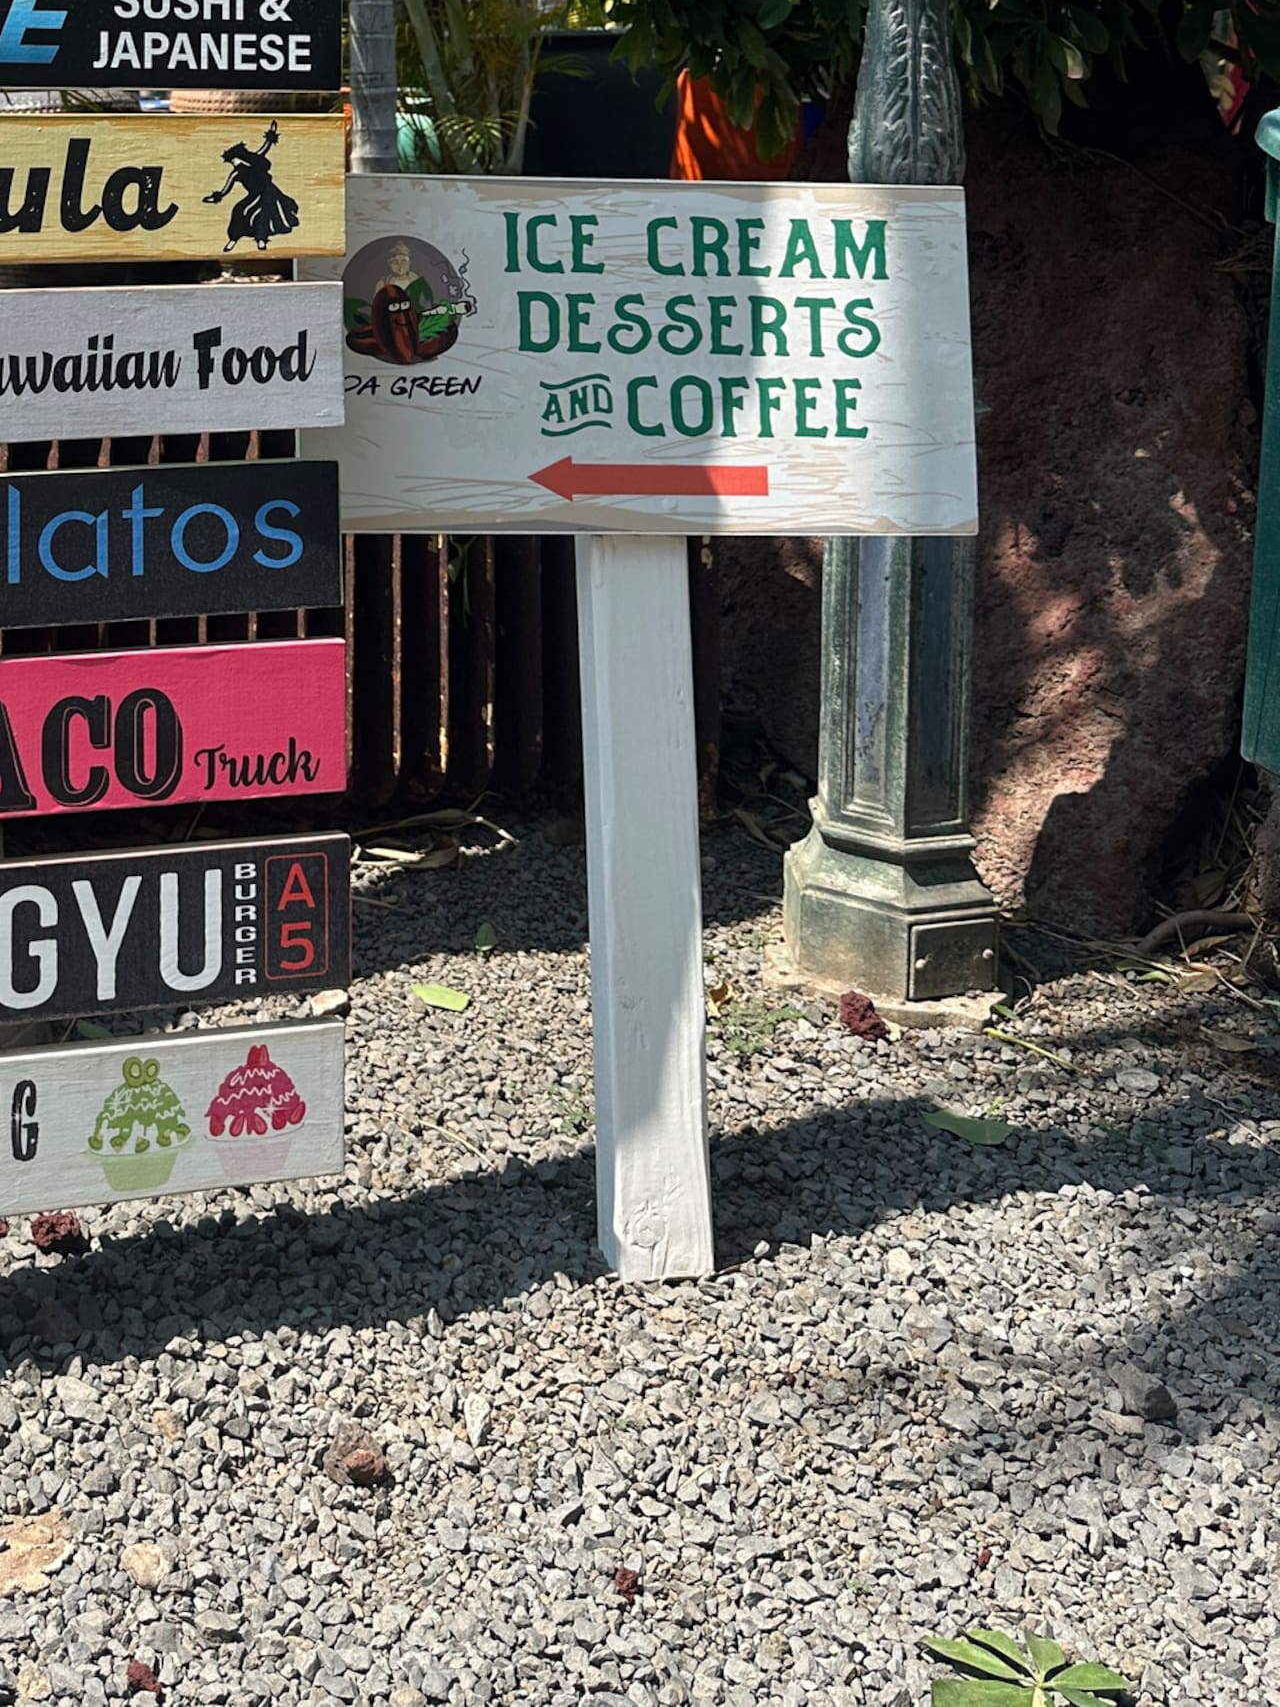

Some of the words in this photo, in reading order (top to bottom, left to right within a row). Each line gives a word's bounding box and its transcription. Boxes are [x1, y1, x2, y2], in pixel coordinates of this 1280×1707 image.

[92, 29, 313, 72] JAPANESE
[503, 211, 606, 275] ICE
[646, 215, 888, 280] CREAM
[193, 325, 315, 386] Food
[517, 290, 882, 358] DESSERTS
[391, 375, 482, 399] GREEN
[540, 379, 614, 423] AND
[626, 374, 869, 439] COFFEE
[193, 736, 320, 791] Truck
[234, 863, 257, 985] BURGER
